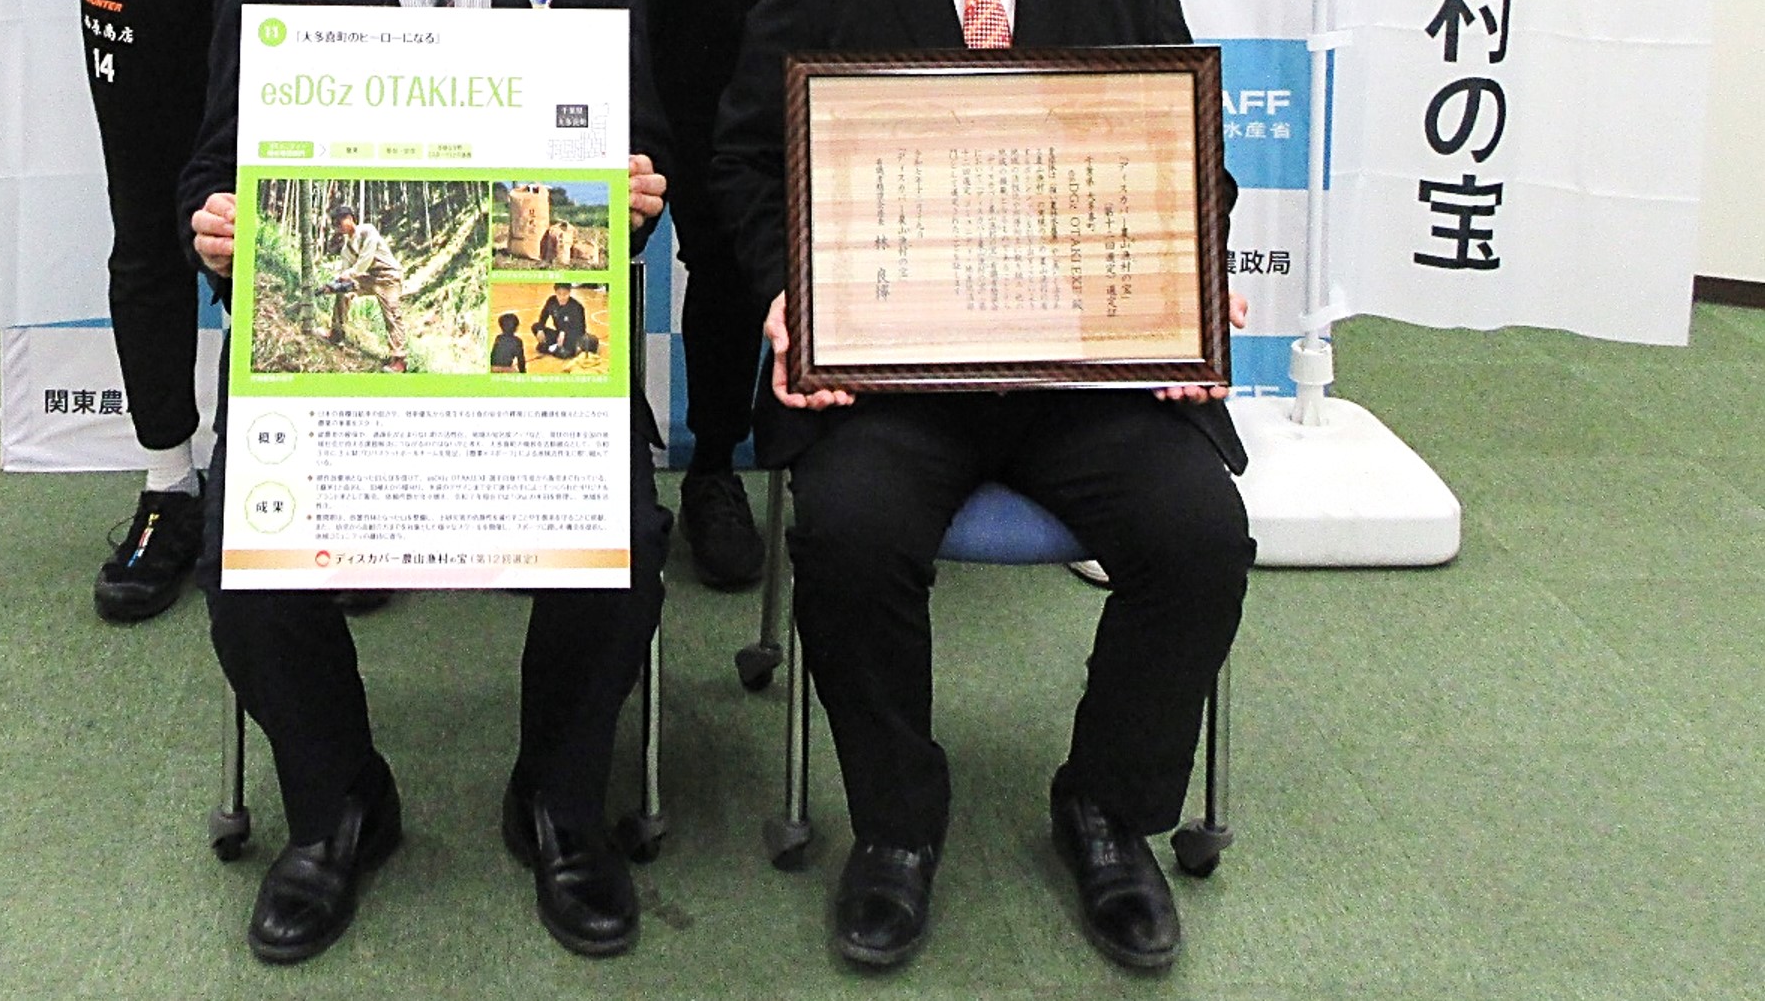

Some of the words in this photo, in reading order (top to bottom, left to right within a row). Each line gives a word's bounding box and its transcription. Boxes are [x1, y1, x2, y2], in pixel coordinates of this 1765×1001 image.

[93, 47, 115, 83] 14
[260, 74, 354, 107] esDGz
[365, 74, 524, 108] OTAKI.EXE
[1225, 122, 1291, 139] 水産省
[44, 389, 131, 415] 関東農
